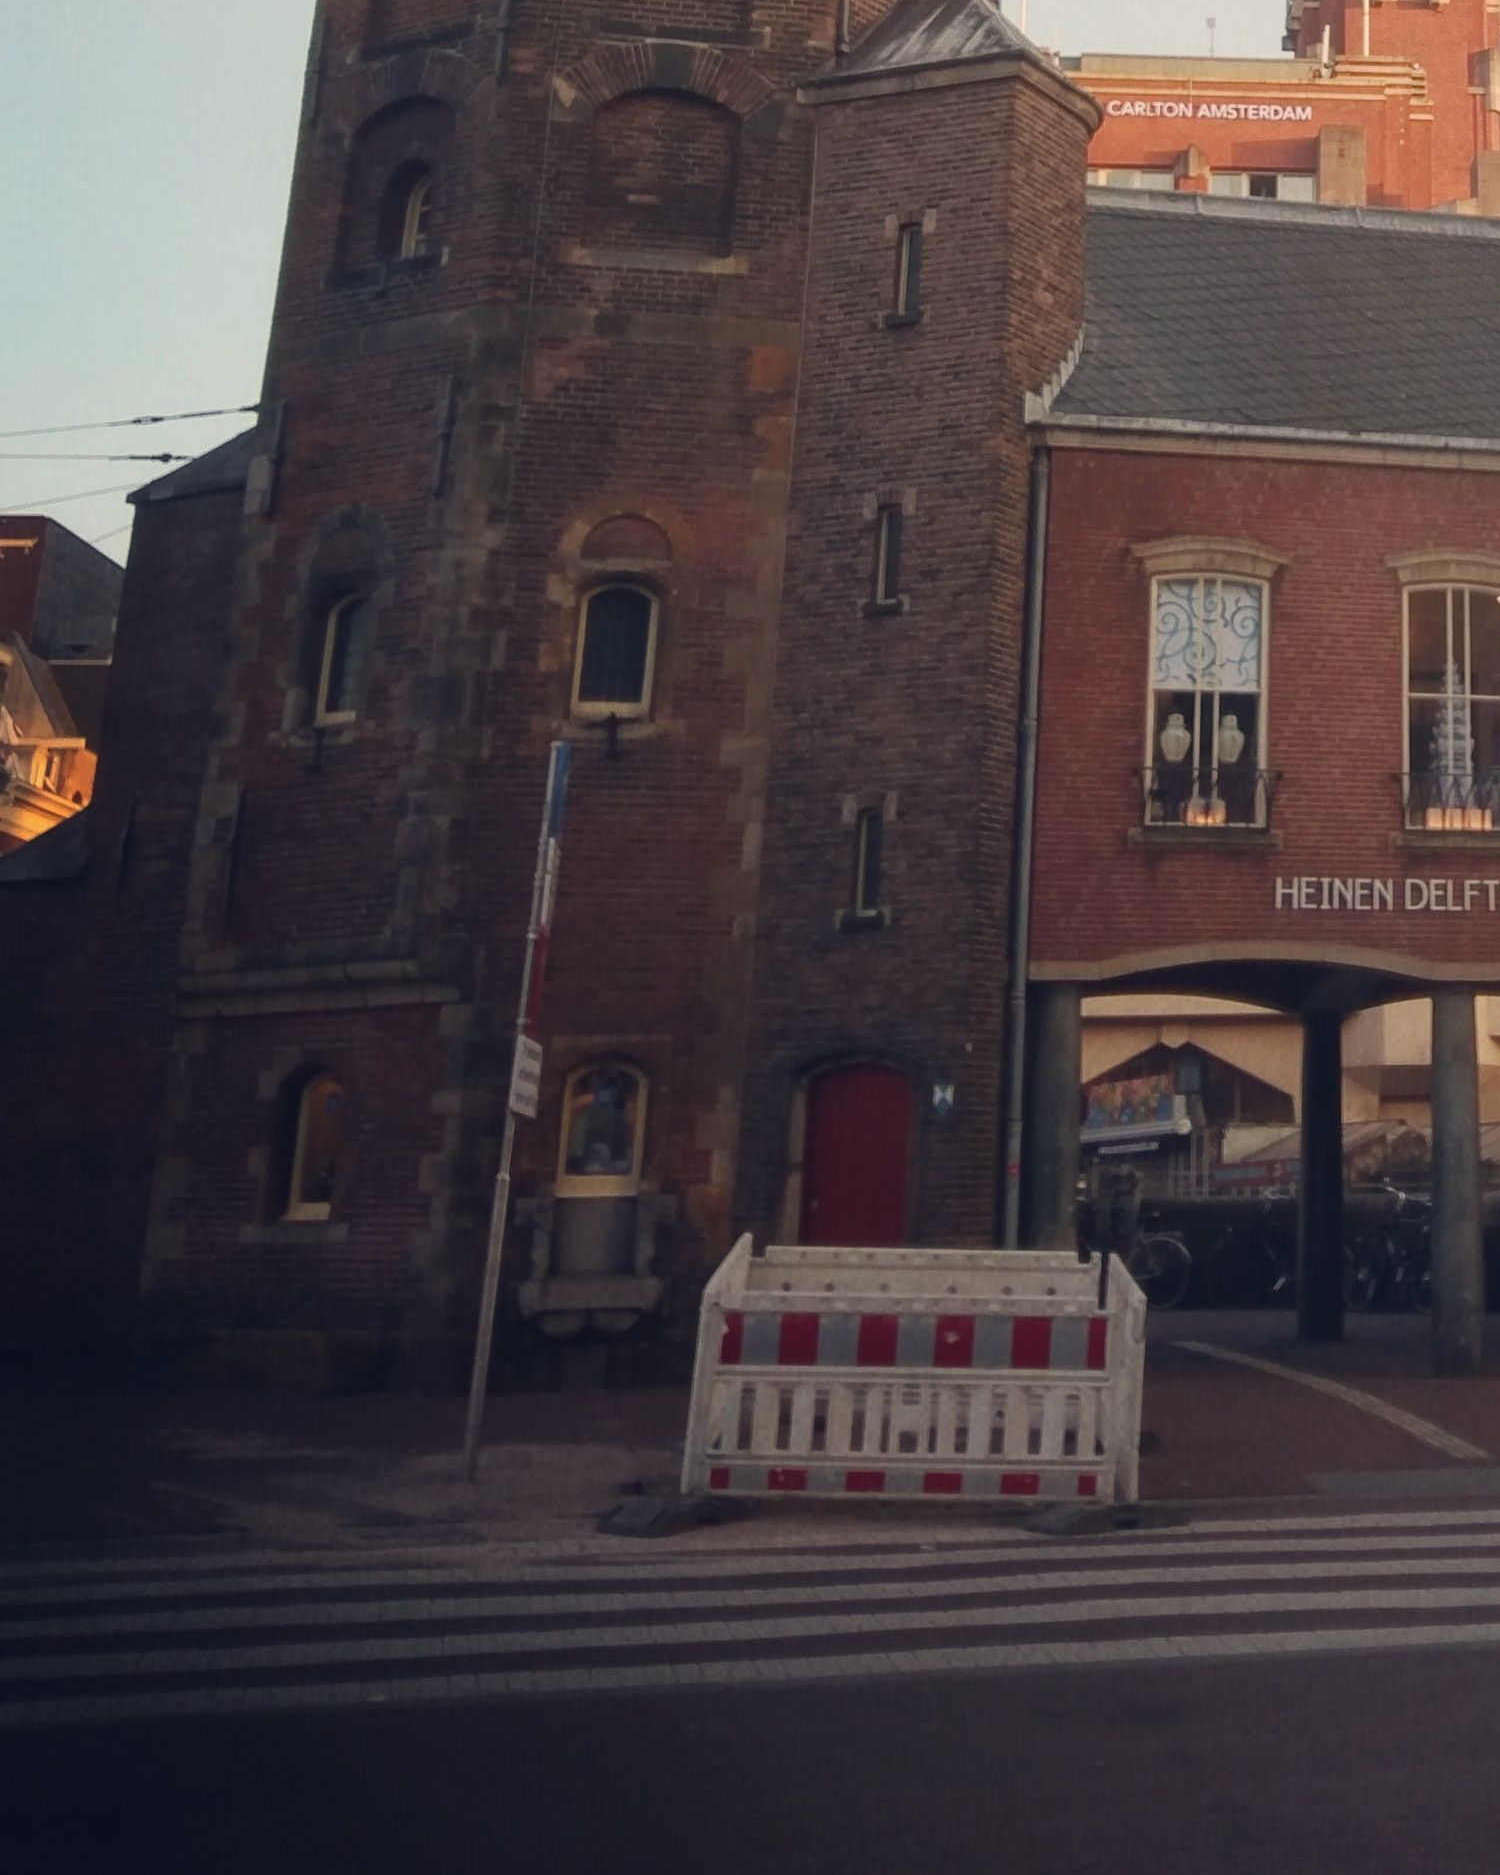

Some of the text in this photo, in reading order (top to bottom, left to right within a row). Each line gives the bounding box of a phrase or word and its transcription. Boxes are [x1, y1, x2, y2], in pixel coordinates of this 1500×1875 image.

[1106, 100, 1313, 121] CARLTON AMSTERDAM
[1275, 876, 1394, 911] HEINEN
